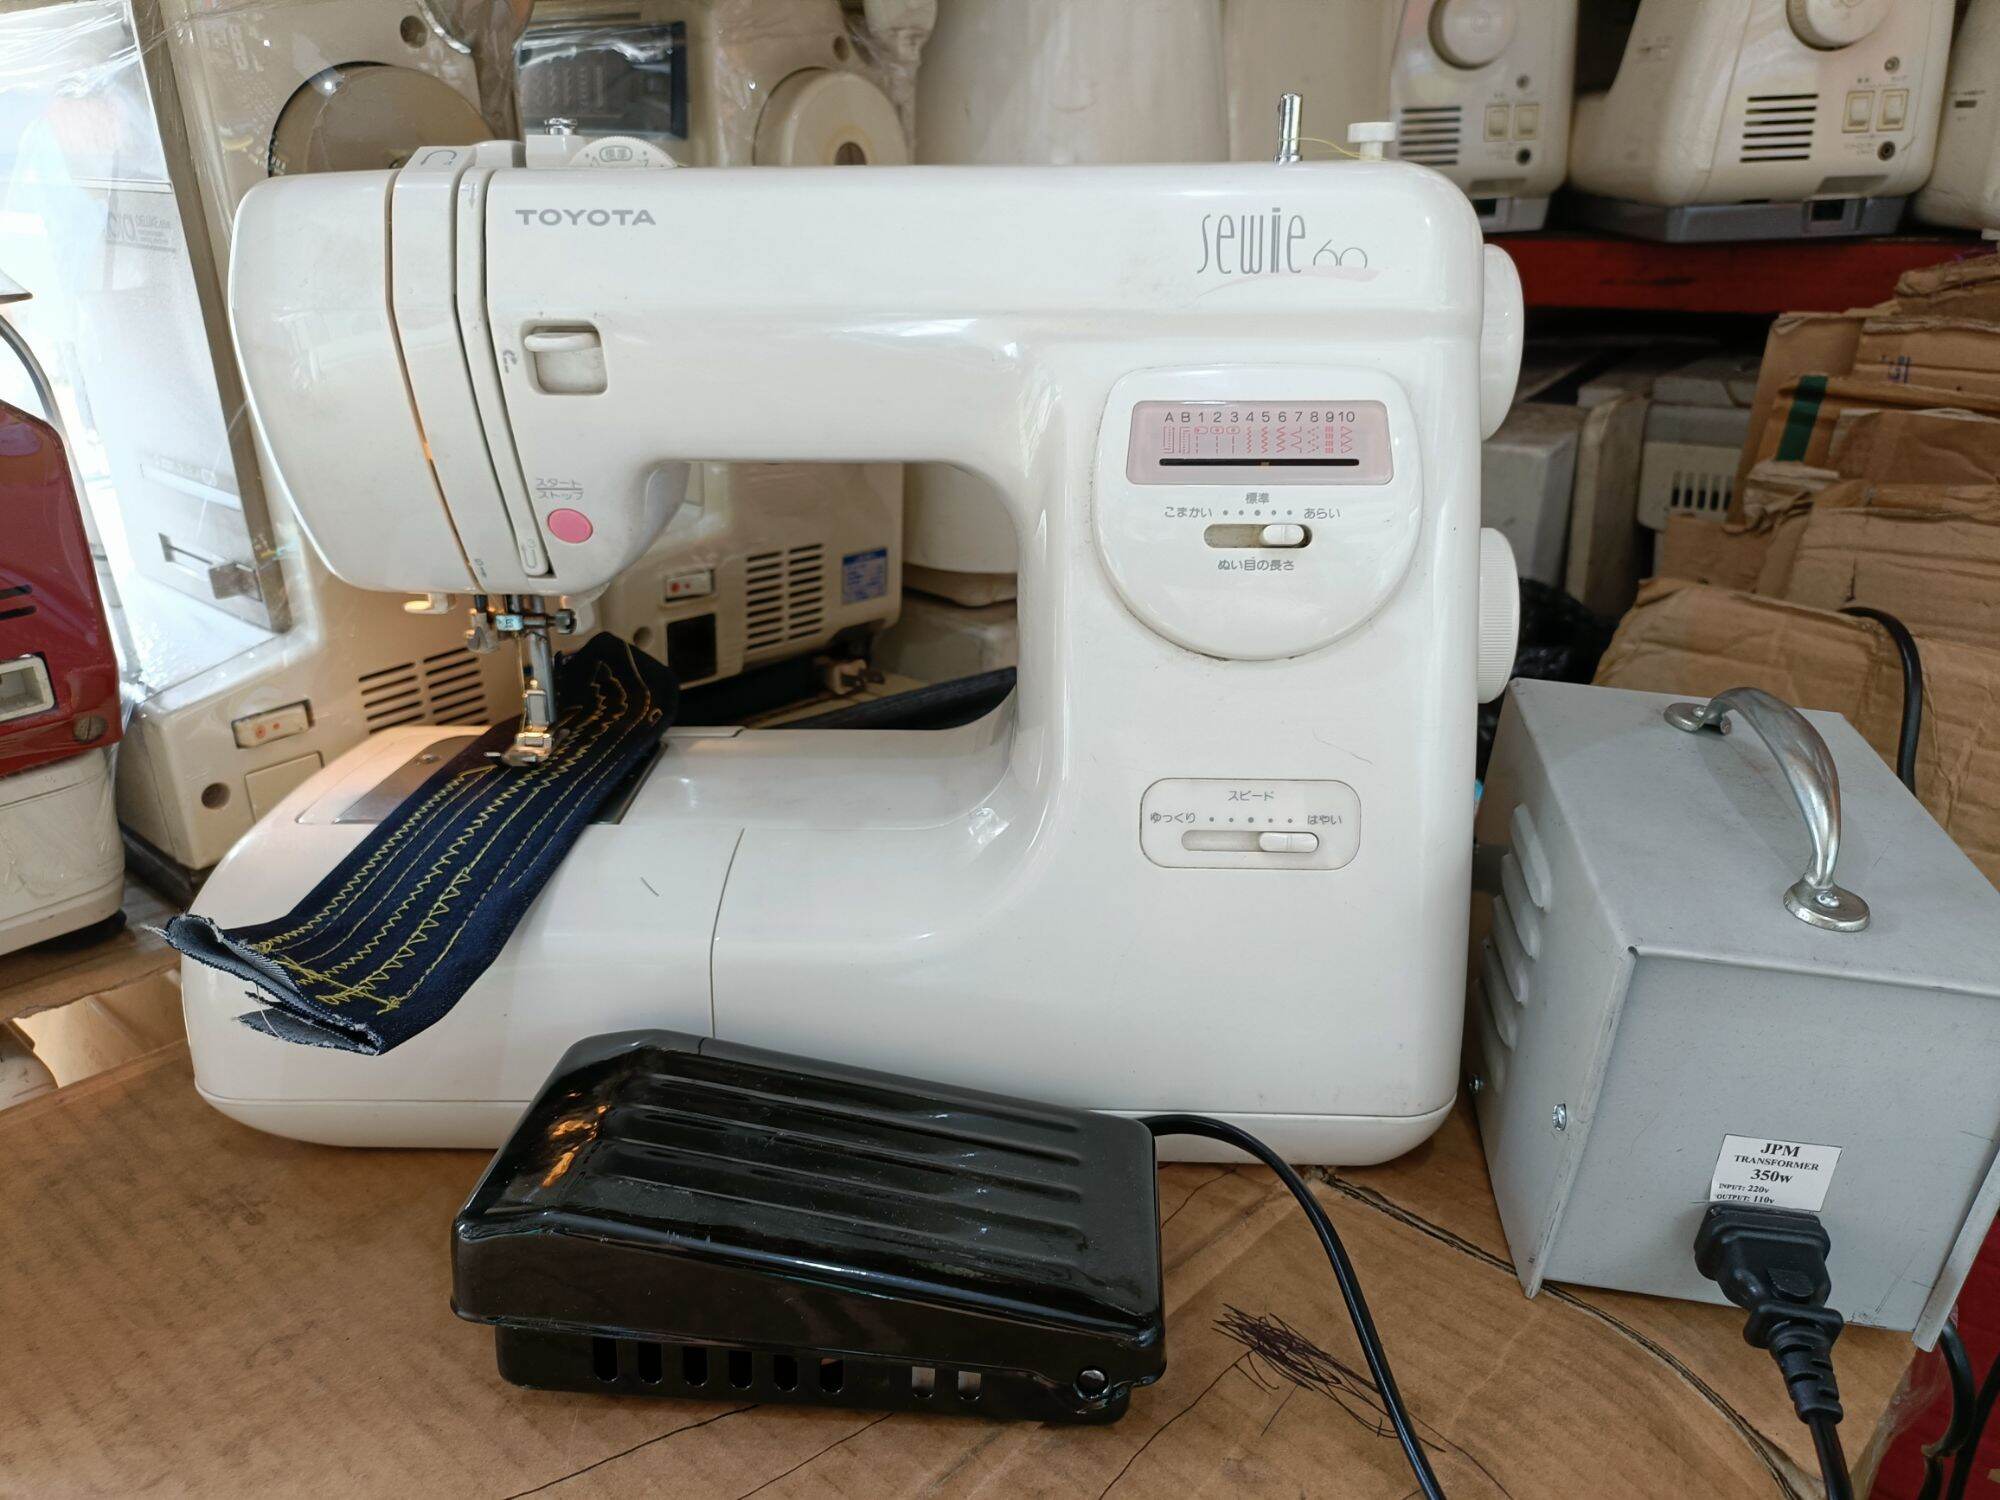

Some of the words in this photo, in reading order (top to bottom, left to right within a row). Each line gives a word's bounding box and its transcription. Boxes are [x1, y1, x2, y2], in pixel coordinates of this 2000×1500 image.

[515, 208, 657, 226] TOYOTA
[1164, 411, 1174, 423] A
[1181, 411, 1191, 423] B
[1198, 411, 1204, 423] 1
[1213, 411, 1222, 423] 2
[1230, 411, 1239, 423] 3
[1245, 411, 1254, 423] 4
[1261, 411, 1270, 423] 5
[1278, 411, 1287, 423] 6
[1295, 411, 1303, 423] 7
[1310, 411, 1319, 423] 8
[1325, 411, 1334, 423] 9
[1338, 411, 1355, 423] 10
[1245, 492, 1270, 504] 標準
[1164, 506, 1213, 518] こまかい
[1304, 507, 1341, 519] あらい
[1217, 559, 1295, 571] ぬい目の長さ
[1228, 790, 1275, 801] スピード
[1150, 812, 1196, 823] ゆっくり
[1307, 815, 1342, 825] はやい
[1760, 1143, 1801, 1157] JPM
[1734, 1155, 1819, 1171] TRANSFORMER
[1750, 1169, 1793, 1184] 350w
[1747, 1184, 1770, 1193] 220v
[1716, 1194, 1750, 1202] OUTPUT:
[1753, 1195, 1776, 1204] 110v
